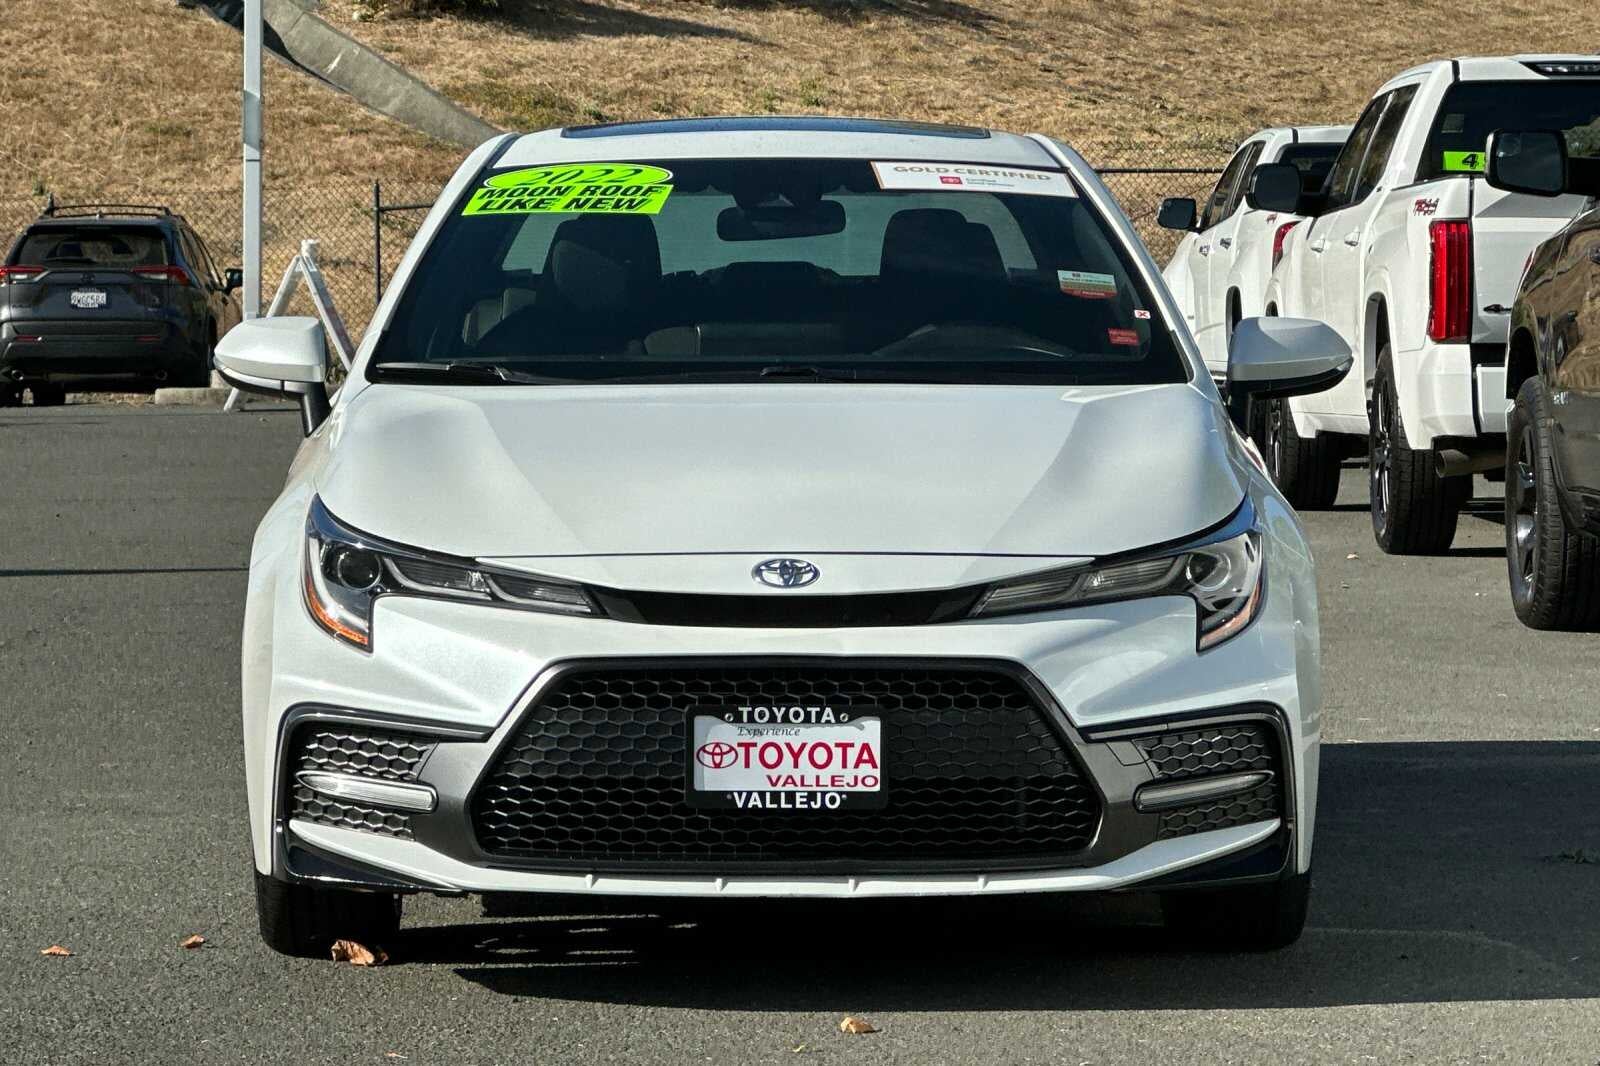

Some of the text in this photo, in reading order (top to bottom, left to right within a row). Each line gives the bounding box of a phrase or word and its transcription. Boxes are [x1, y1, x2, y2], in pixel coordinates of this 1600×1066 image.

[516, 168, 642, 186] 2022
[893, 166, 949, 174] GOLD
[953, 168, 1050, 181] CERTIFIED
[480, 185, 662, 199] MOON ROOF
[478, 198, 651, 212] LIKE NEW
[738, 707, 836, 723] TOYOTA
[737, 726, 800, 737] Experience
[737, 742, 878, 769] TOYOTA
[766, 775, 879, 788] VALLEJO
[733, 792, 841, 809] VALLEJO
